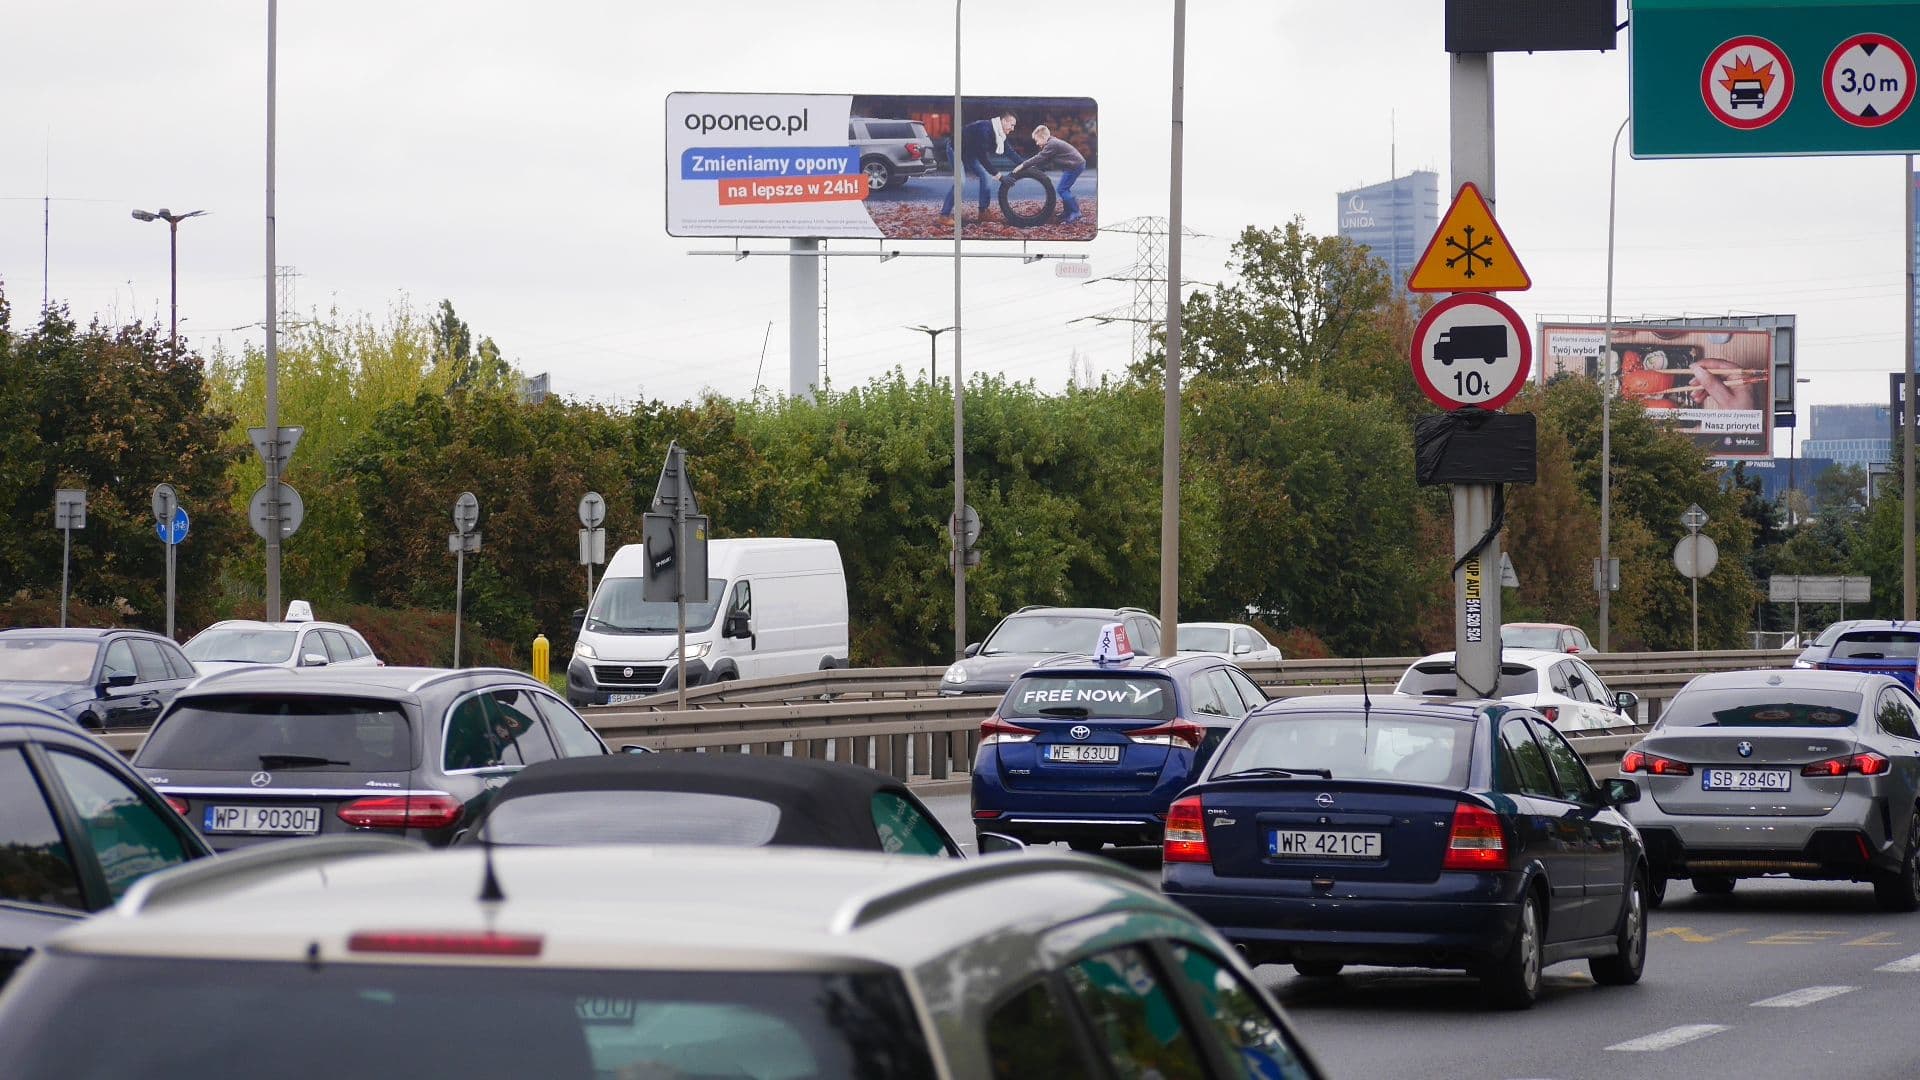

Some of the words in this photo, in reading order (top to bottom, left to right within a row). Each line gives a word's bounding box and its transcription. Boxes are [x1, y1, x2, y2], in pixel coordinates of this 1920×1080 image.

[1840, 68, 1876, 96] 3,0
[1879, 76, 1899, 92] m
[684, 108, 808, 136] oponeo.pl
[692, 156, 790, 174] Zmieniamy
[795, 157, 848, 173] opony
[728, 186, 747, 197] na
[752, 182, 803, 199] lepsze
[808, 184, 819, 195] w
[823, 180, 859, 195] 24h!
[1552, 346, 1571, 355] Twój
[1572, 346, 1597, 355] wybór
[1705, 421, 1724, 430] Nasz
[1726, 421, 1760, 432] priorytet
[1102, 630, 1111, 653] TAXI
[1023, 689, 1073, 704] FREE
[1077, 689, 1128, 703] NOW
[1053, 746, 1071, 759] WE
[1075, 747, 1116, 760] 163UU
[1713, 772, 1733, 786] SB
[1739, 772, 1786, 787] 284GY
[215, 808, 248, 828] WPI
[258, 809, 317, 829] 9030H
[1281, 833, 1307, 852] WR
[1315, 834, 1376, 854] 421CF
